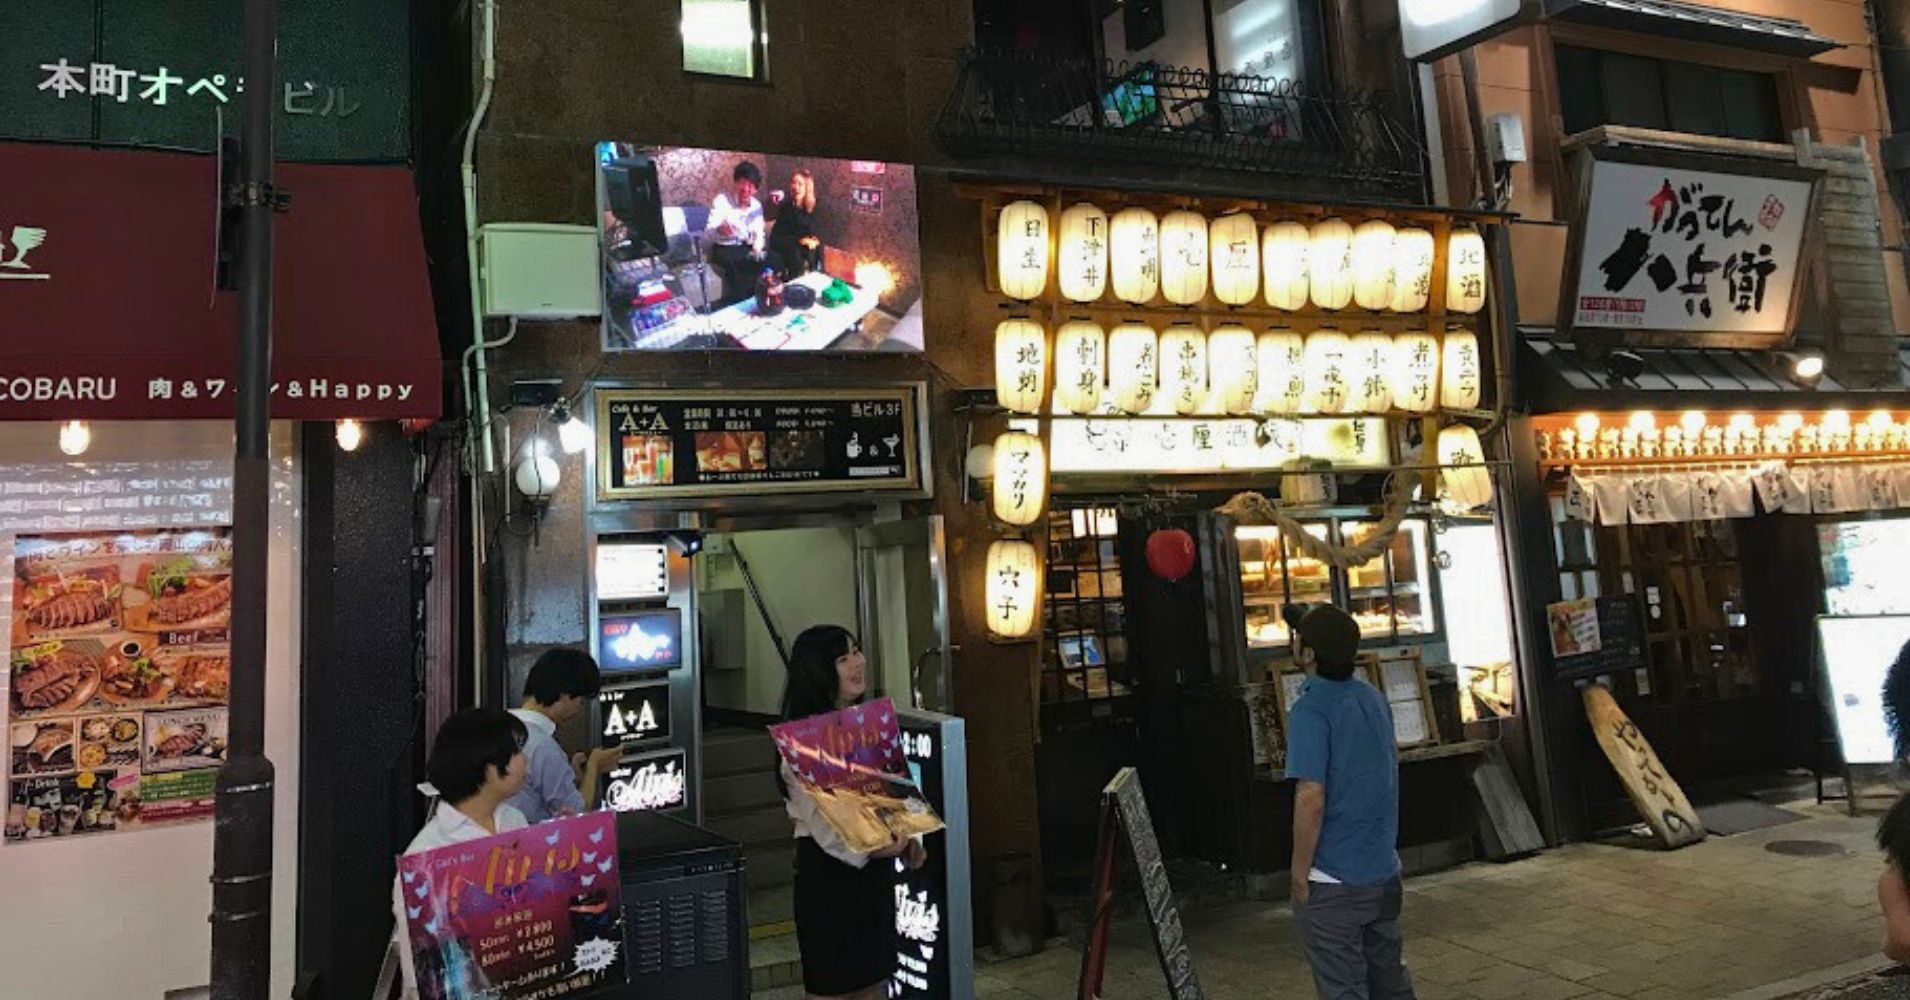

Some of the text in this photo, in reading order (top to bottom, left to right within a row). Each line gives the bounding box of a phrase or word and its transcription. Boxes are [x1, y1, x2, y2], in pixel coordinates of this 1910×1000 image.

[38, 58, 360, 117] 本町オペビル
[1646, 177, 1753, 241] がってん
[1599, 226, 1777, 318] 八兵衛
[1077, 337, 1098, 395] 刺身
[619, 411, 670, 431] A+A
[998, 565, 1020, 619] 穴子
[603, 699, 659, 736] A+A
